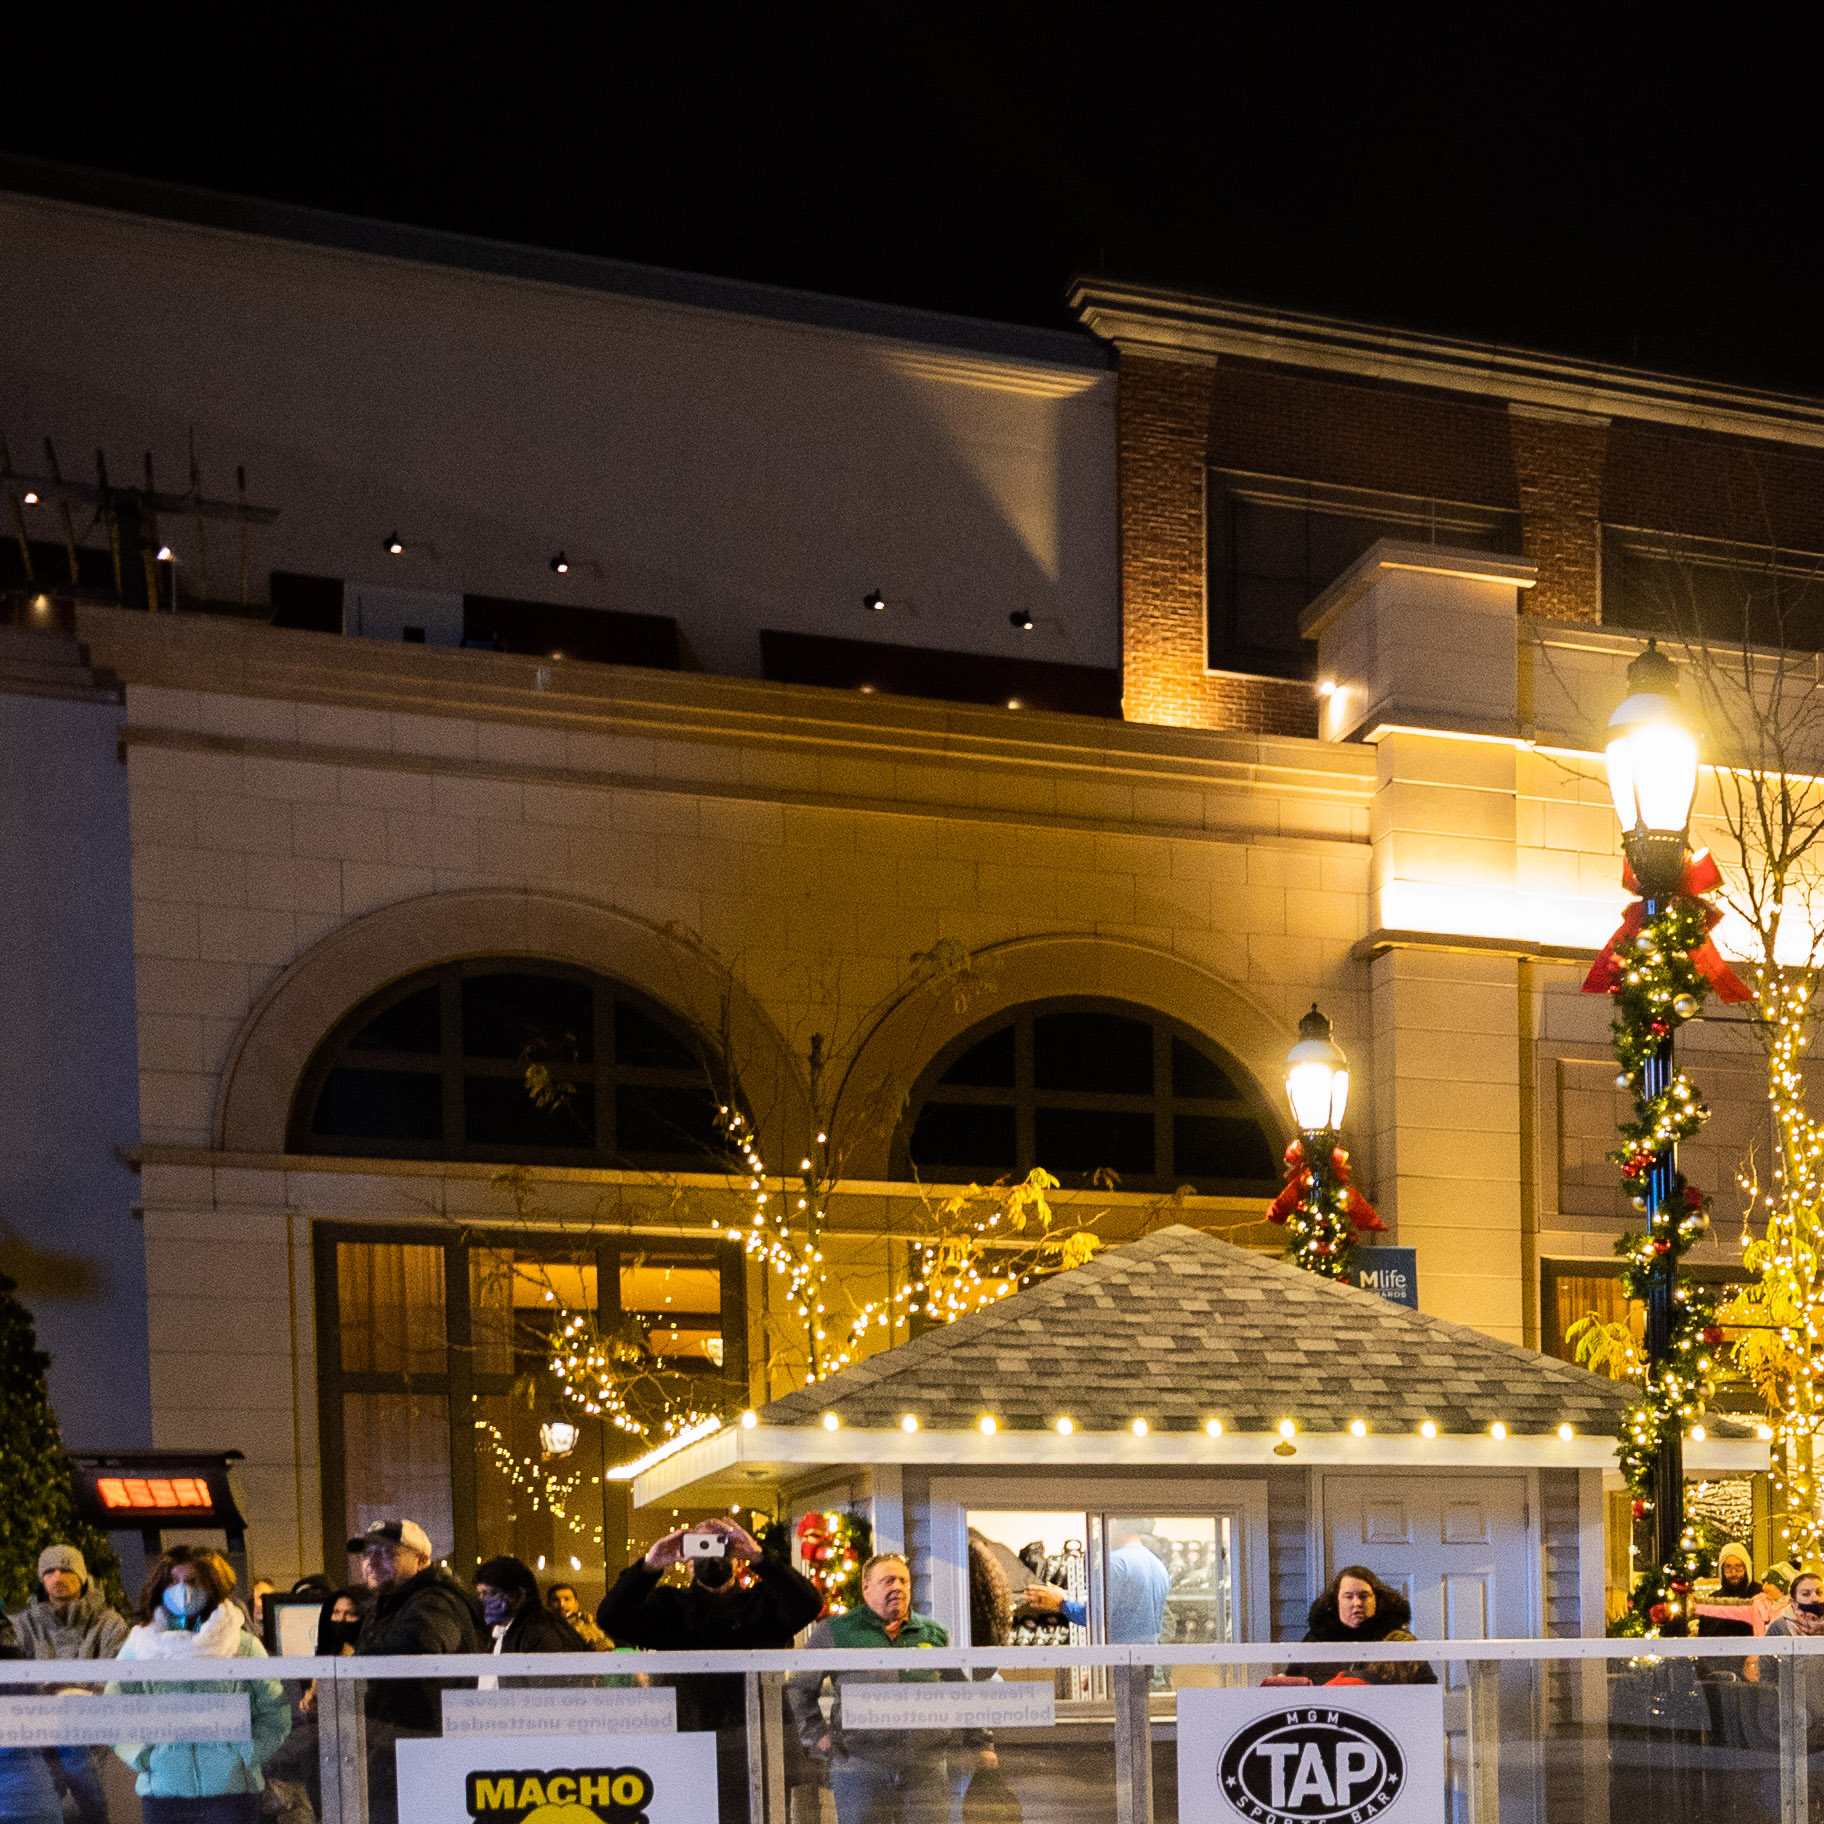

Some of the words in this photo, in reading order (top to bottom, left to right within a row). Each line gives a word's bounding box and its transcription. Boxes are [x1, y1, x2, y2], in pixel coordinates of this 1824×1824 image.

[1286, 1710, 1339, 1725] MGM
[475, 1774, 644, 1810] MACHO
[1256, 1742, 1378, 1808] TAP
[1351, 1792, 1391, 1824] BAR
